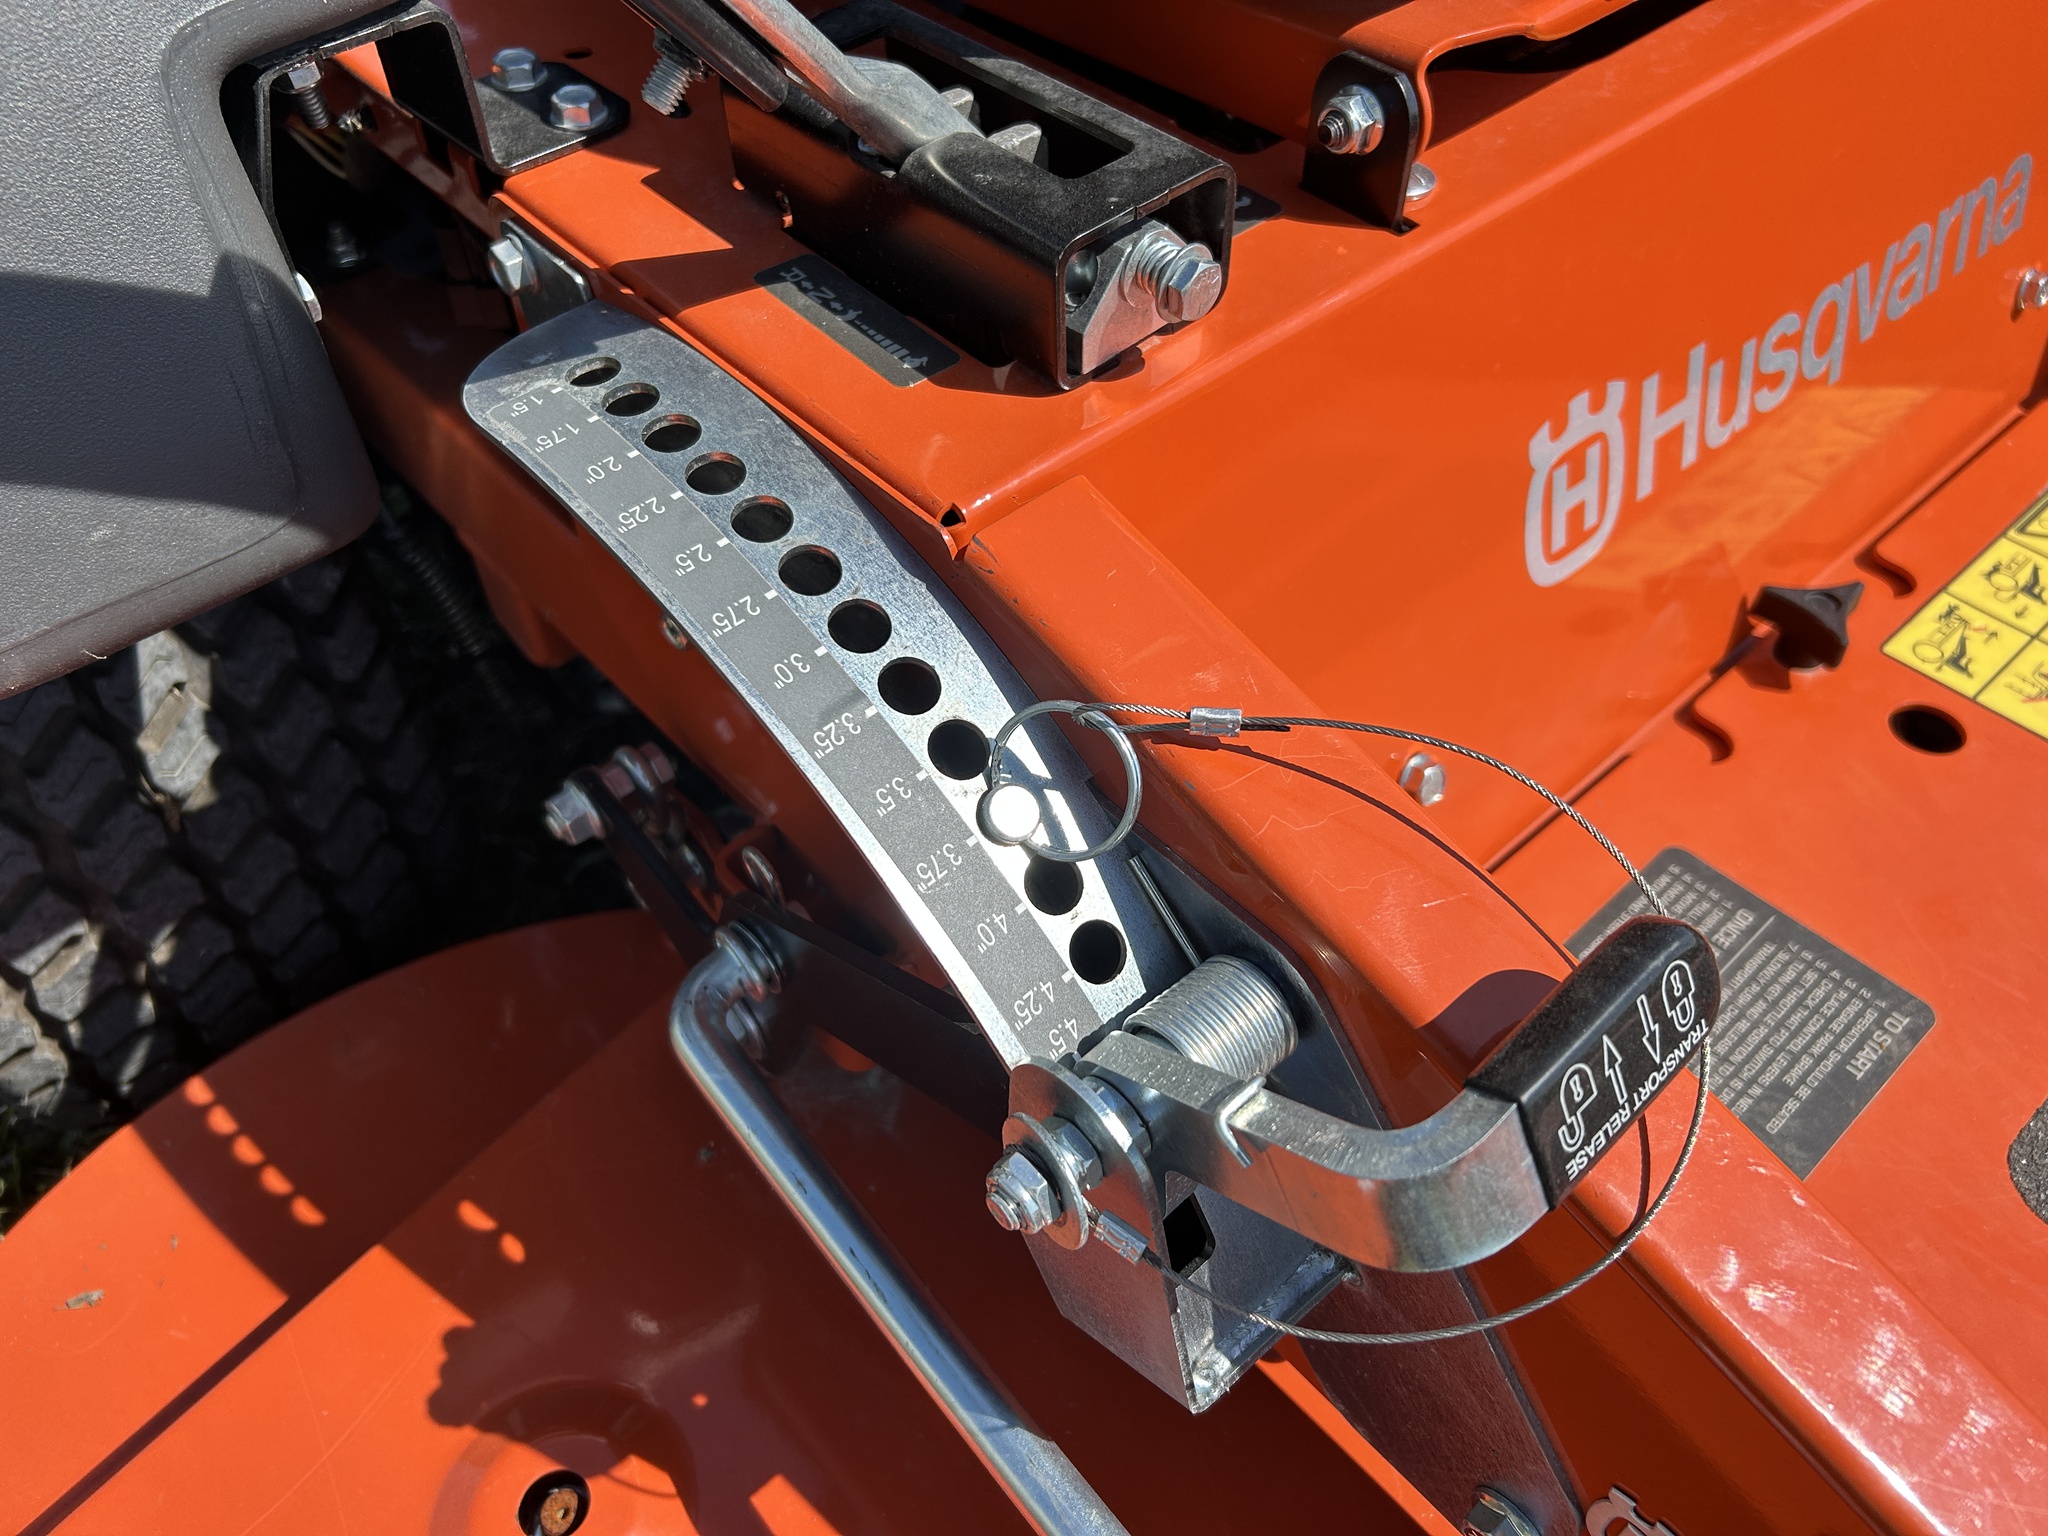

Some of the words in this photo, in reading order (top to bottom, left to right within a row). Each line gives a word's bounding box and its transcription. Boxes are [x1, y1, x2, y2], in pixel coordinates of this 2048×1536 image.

[779, 267, 807, 282] R
[806, 286, 836, 305] N
[1636, 153, 2032, 501] Husqvarna
[511, 396, 543, 417] 1.5"
[535, 423, 580, 453] 1.75"
[585, 456, 623, 485] 2.0"
[618, 497, 666, 533] 2.25"
[675, 543, 712, 576] 2.5"
[712, 595, 761, 637] 2.75"
[773, 653, 811, 689] 3.0"
[813, 712, 862, 759] 3.25"
[875, 777, 912, 817] 3.5"
[916, 843, 962, 892] 3.75"
[976, 913, 1008, 954] 4.0"
[1711, 906, 1756, 949] ONCE
[1726, 939, 1776, 991] TRANSPORT
[1753, 949, 1791, 986] SLOWLY
[1776, 958, 1805, 986] TURN
[1797, 968, 1819, 988] SET
[1013, 981, 1054, 1032] 4.25"
[1732, 981, 1761, 1009] PUSH
[1744, 998, 1769, 1021] AND
[1761, 982, 1783, 1002] KEY
[1762, 984, 1805, 1027] THROTTLE
[1801, 977, 1835, 1009] CHECK
[1818, 987, 1849, 1018] PLACE
[1783, 1005, 1810, 1031] THAT
[1826, 996, 1864, 1034] ENGAGE
[1833, 1007, 1880, 1053] OPERATOR
[1882, 1010, 1909, 1034] TO
[1049, 1018, 1078, 1060] 4.5"
[1710, 1017, 1751, 1058] RELEASE
[1727, 1022, 1770, 1066] POSITION
[1767, 1026, 1791, 1048] PTO
[1785, 1013, 1826, 1055] CONTROL
[1806, 1030, 1835, 1057] PARK
[1633, 1018, 1709, 1112] TRANSPORT
[1717, 1061, 1735, 1077] TO
[1736, 1043, 1775, 1081] SWITCH
[1756, 1051, 1793, 1087] LEVERS
[1780, 1053, 1815, 1086] BRAKE
[1803, 1049, 1843, 1088] SHOULD
[1841, 1028, 1895, 1080] START
[1728, 1077, 1745, 1091] IS
[1746, 1083, 1764, 1099] IN
[1792, 1083, 1812, 1100] BE
[1763, 1096, 1801, 1134] SEATED
[1565, 1101, 1631, 1182] RELEASE
